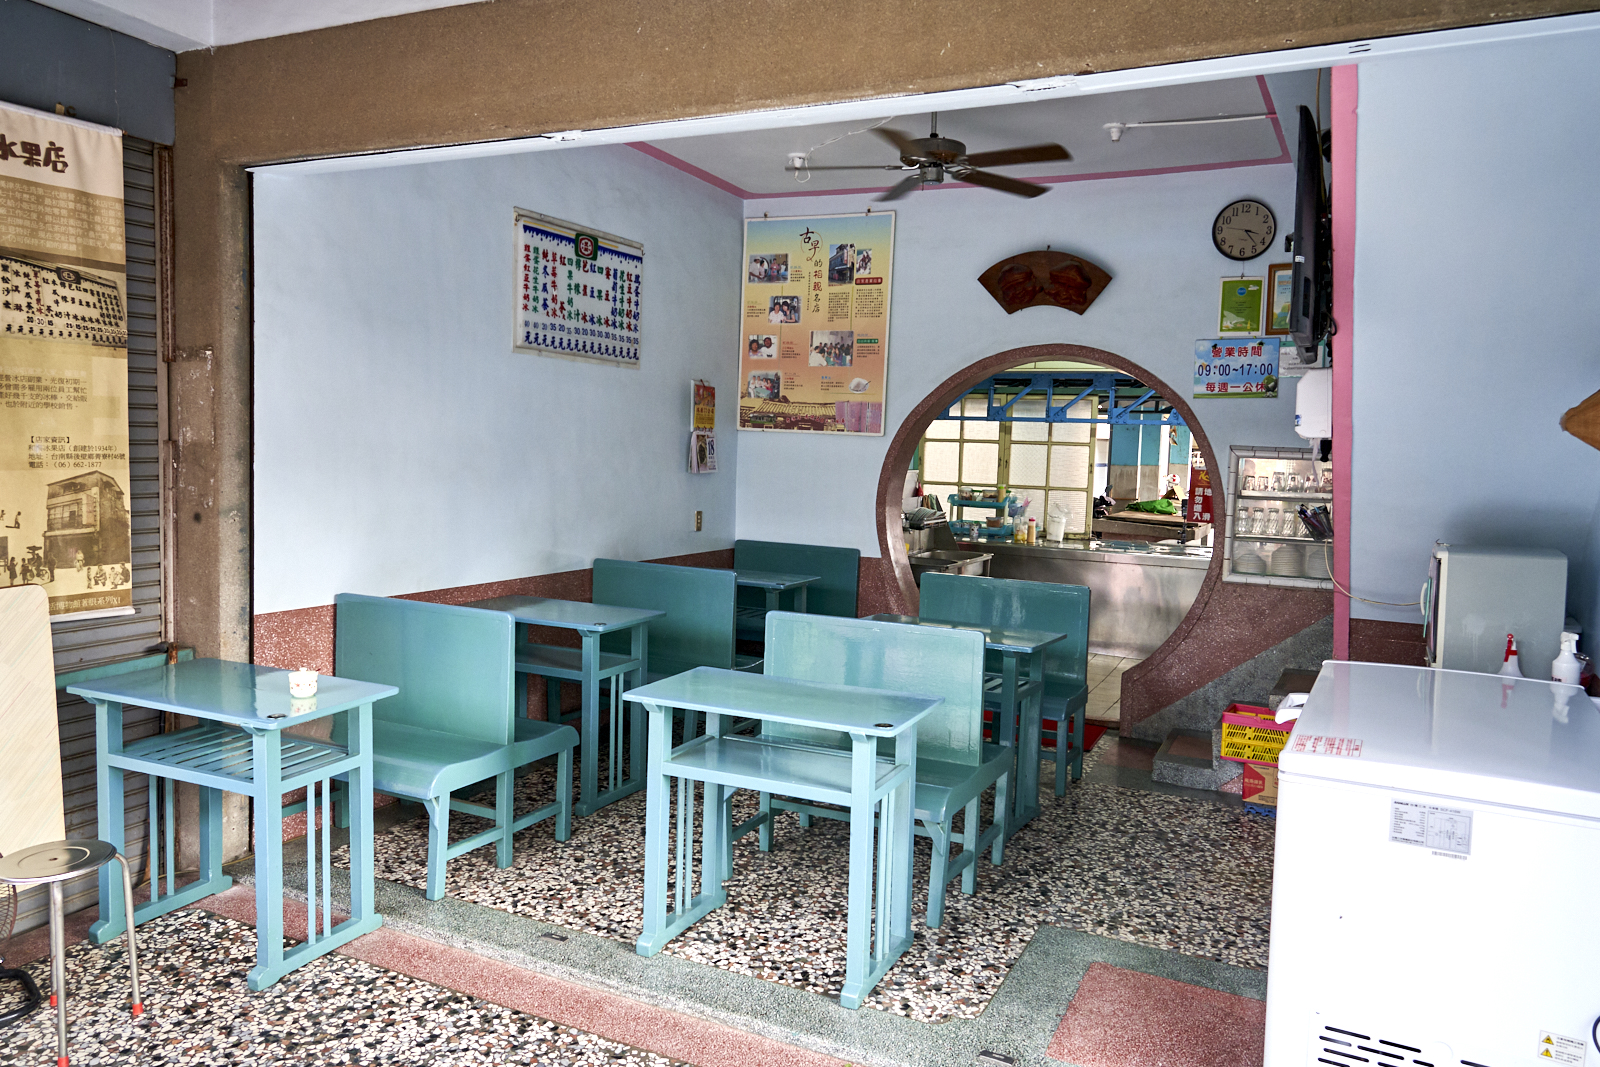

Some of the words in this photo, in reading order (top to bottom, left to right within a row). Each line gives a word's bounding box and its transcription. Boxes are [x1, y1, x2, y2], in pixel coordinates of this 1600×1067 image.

[1232, 207, 1239, 217] 11
[1241, 203, 1251, 213] 12
[1255, 206, 1259, 216] 1
[1222, 216, 1232, 225] 10
[1262, 214, 1269, 224] 2
[1217, 226, 1223, 235] 9
[1266, 225, 1272, 235] 3
[1220, 237, 1226, 246] 8
[1259, 237, 1266, 246] 4
[1228, 245, 1234, 254] 7
[1239, 247, 1245, 256] 6
[1251, 245, 1257, 254] 5
[37, 317, 45, 325] 30
[550, 322, 557, 331] 35
[558, 323, 565, 332] 20
[574, 327, 580, 335] 30
[582, 328, 588, 336] 20
[611, 333, 617, 341] 35
[619, 335, 625, 343] 35
[626, 336, 632, 344] 35
[633, 337, 639, 345] 35
[1211, 345, 1262, 357] 營業時間
[1197, 363, 1273, 377] 09:00~17:00
[1205, 381, 1267, 393] 每週一公休
[708, 439, 715, 456] 18
[1193, 487, 1204, 520] 請勿進入
